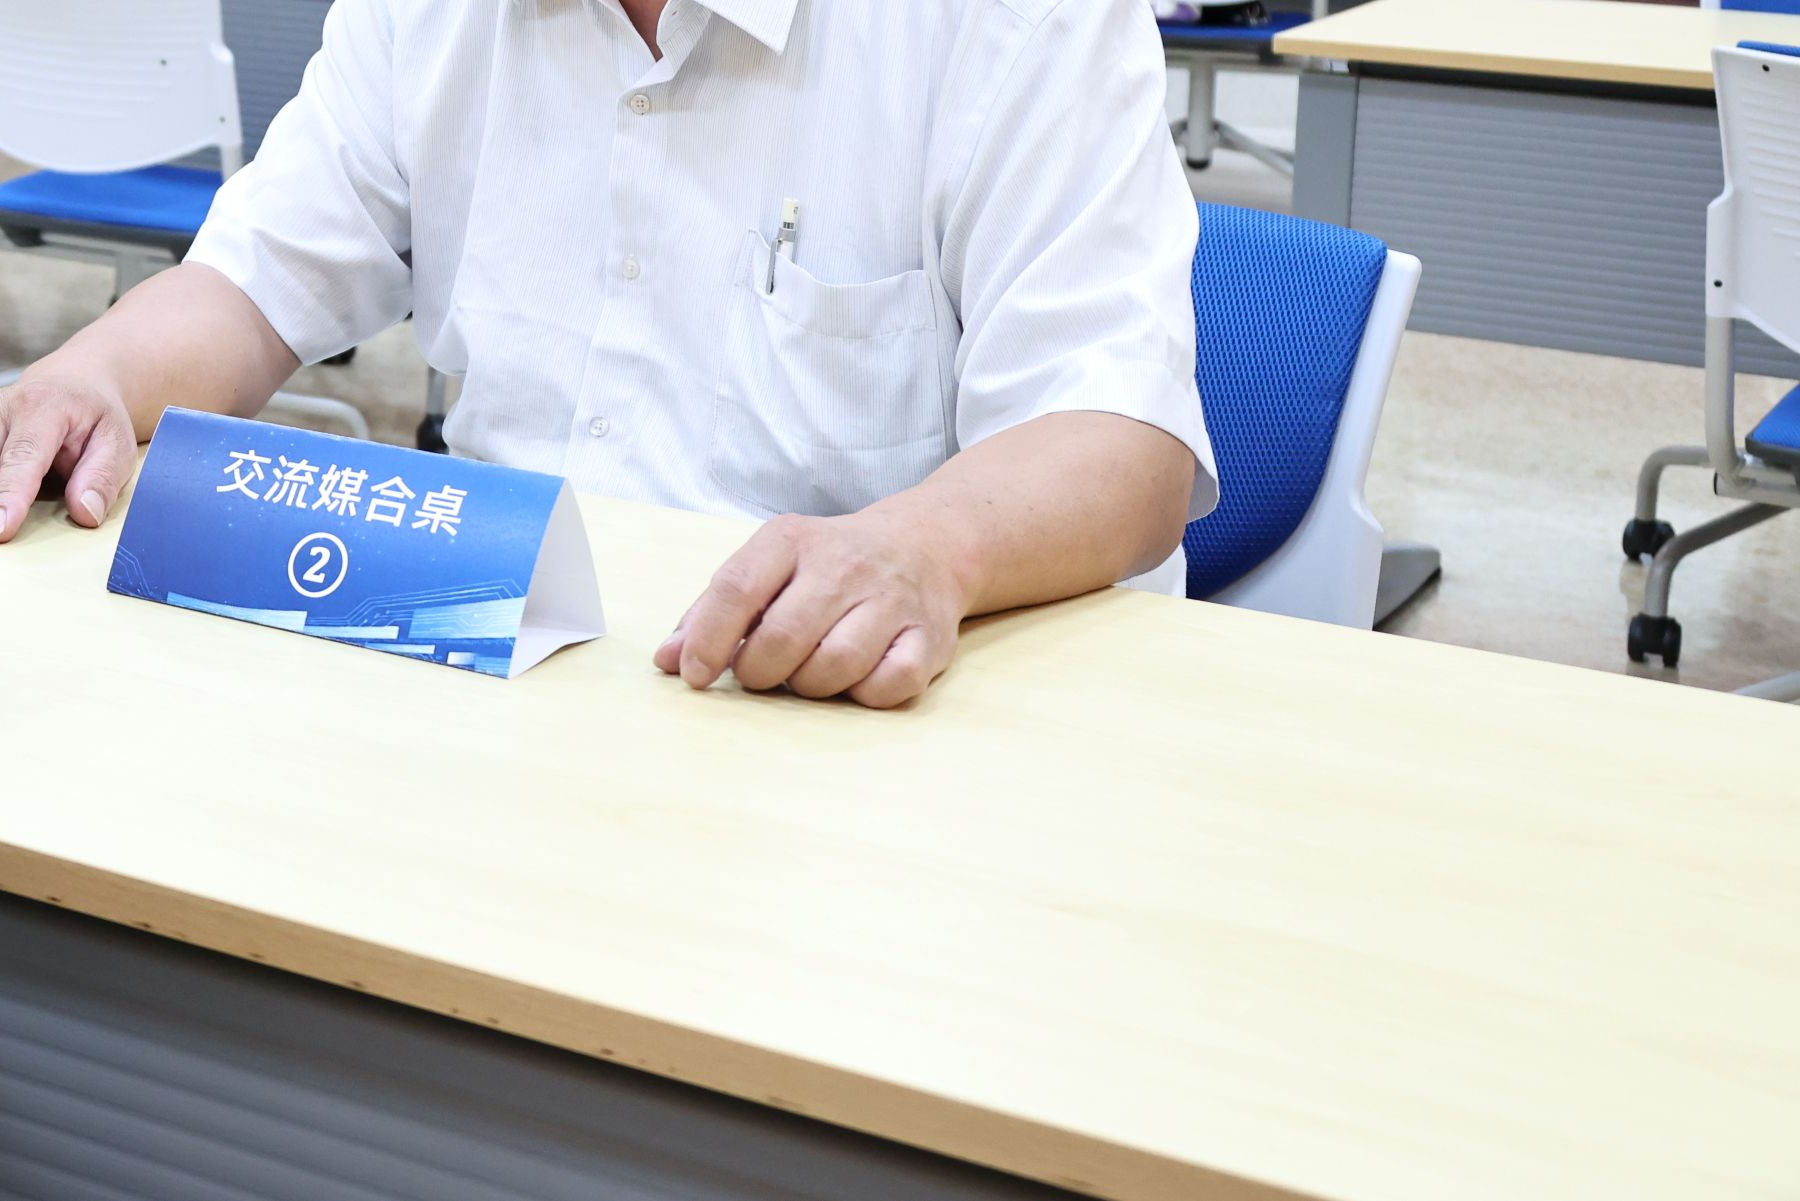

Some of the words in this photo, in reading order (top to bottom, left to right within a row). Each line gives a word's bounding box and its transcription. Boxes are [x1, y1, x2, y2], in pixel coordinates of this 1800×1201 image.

[216, 449, 468, 537] 交流媒合桌
